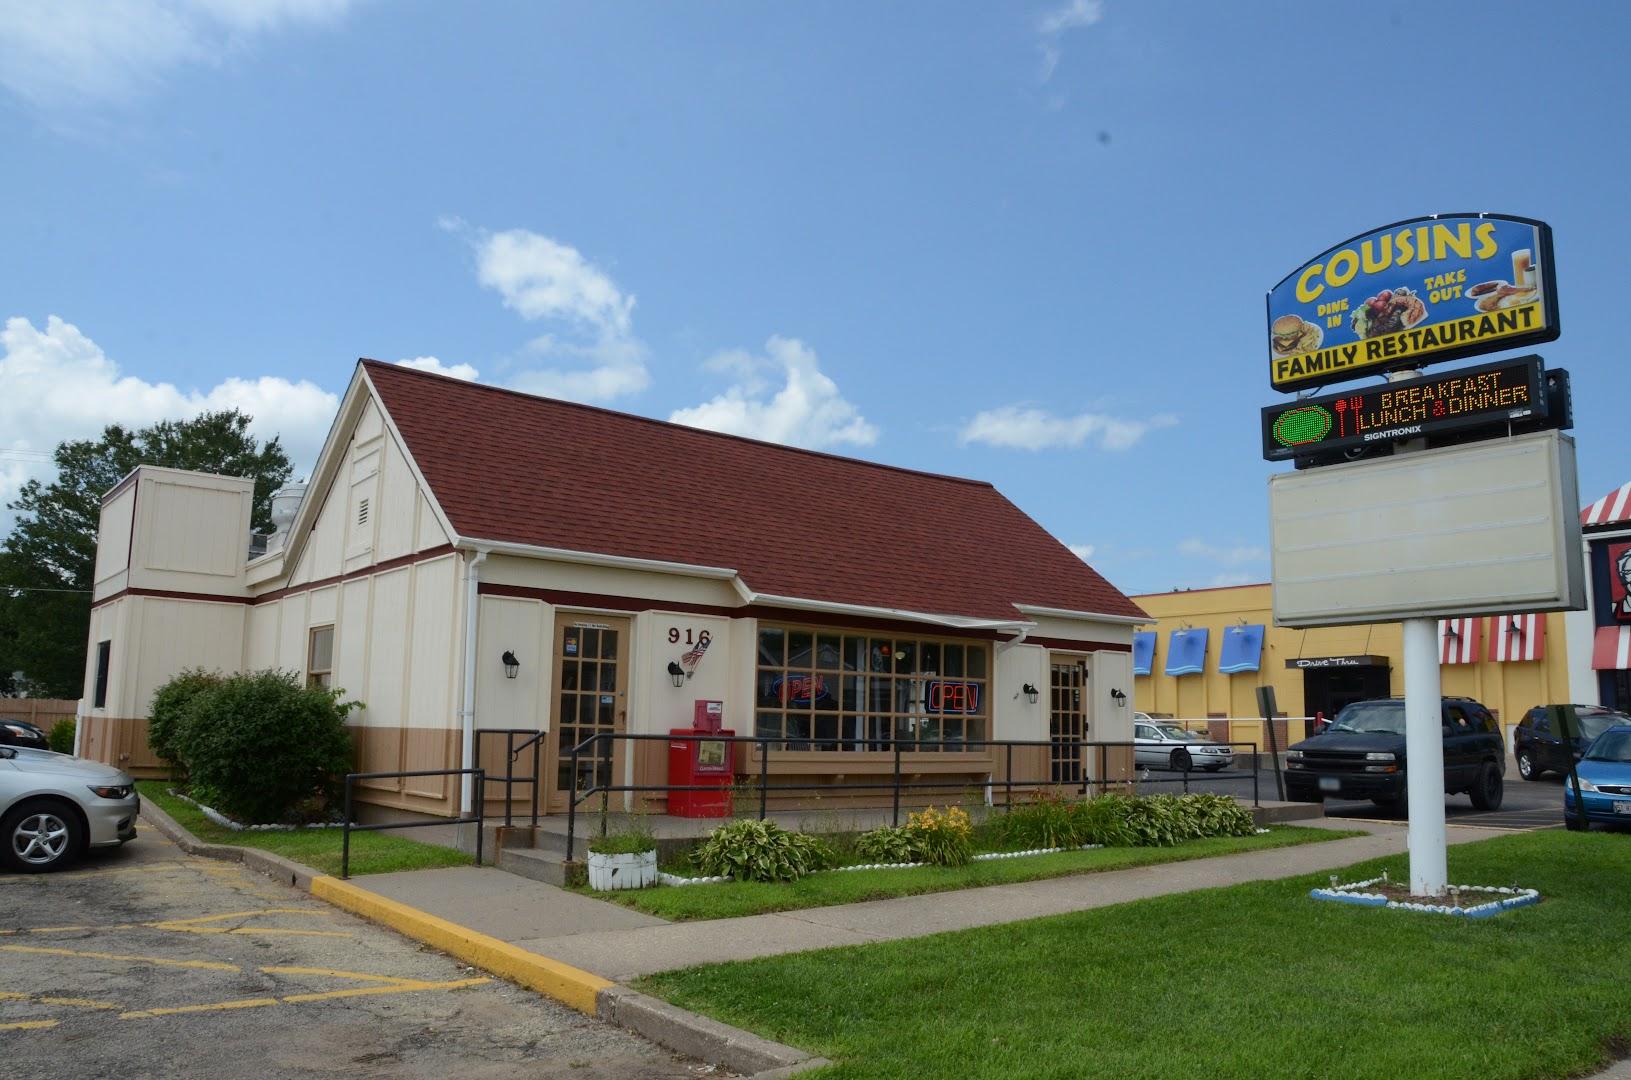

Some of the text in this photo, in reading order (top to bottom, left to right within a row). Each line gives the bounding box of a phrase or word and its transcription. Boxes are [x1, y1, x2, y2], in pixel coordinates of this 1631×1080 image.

[1295, 222, 1498, 303] COUSINS
[1424, 269, 1466, 292] TAKE
[1429, 285, 1463, 304] OUT
[1317, 298, 1349, 317] DINE
[1327, 314, 1342, 329] IN
[1276, 306, 1535, 380] FAMILY RESTAURANT
[1381, 372, 1502, 410] BREAKFAST
[1360, 384, 1529, 430] LUNCH & DINNER
[1363, 425, 1422, 442] SIGNTRONIX
[668, 627, 711, 646] 916
[1296, 657, 1359, 667] Drive Thru
[931, 684, 978, 710] OPEN
